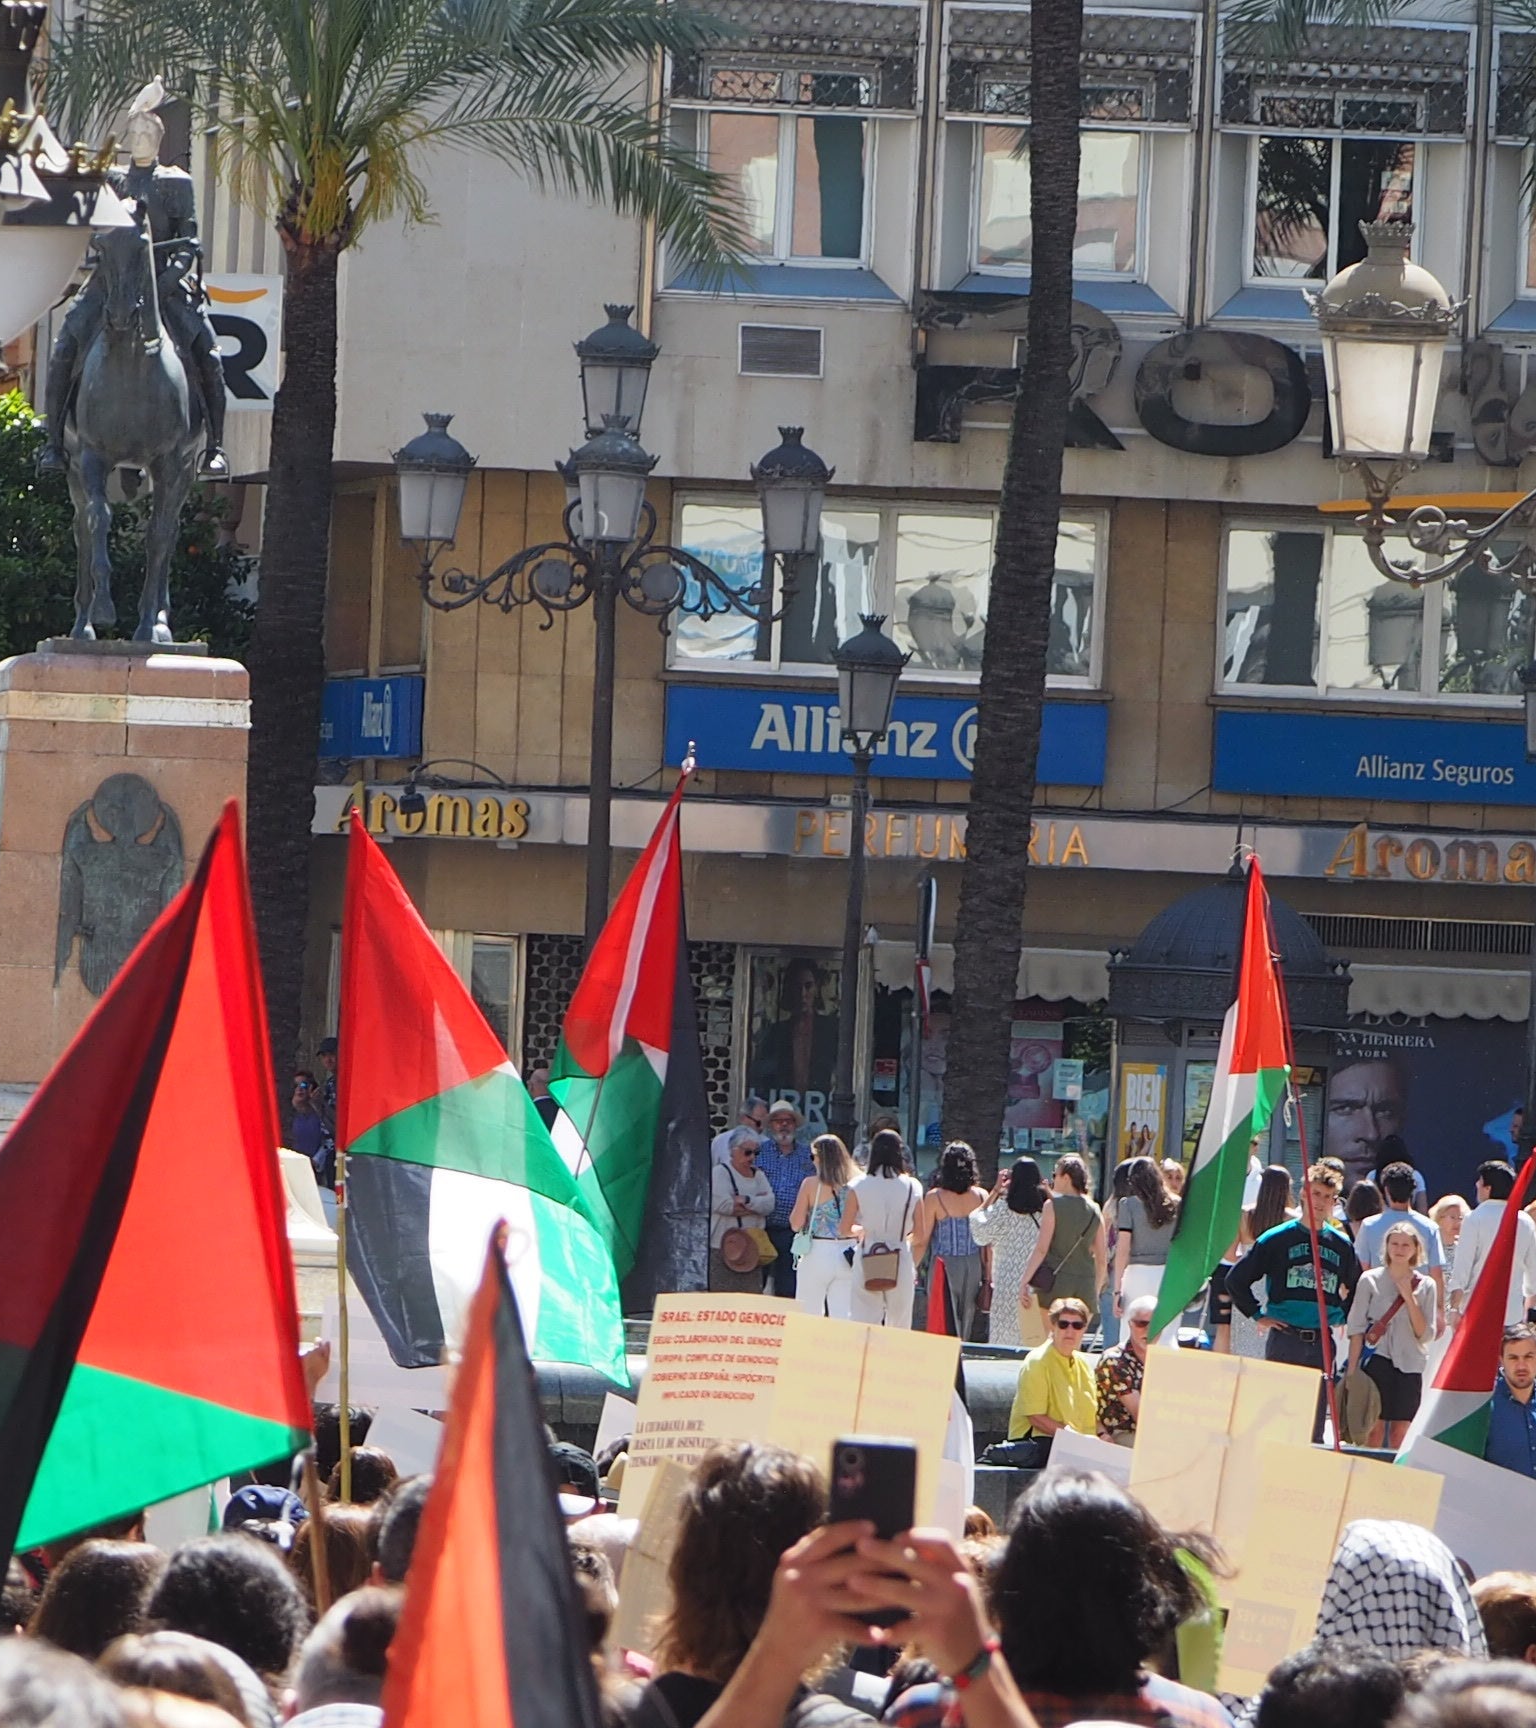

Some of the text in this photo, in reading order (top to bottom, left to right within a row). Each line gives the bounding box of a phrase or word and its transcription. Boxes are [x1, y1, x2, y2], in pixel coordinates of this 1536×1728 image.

[1355, 755, 1515, 786] Allianz Seguros
[793, 809, 1090, 866] PERFUMRIA
[1362, 1033, 1436, 1048] HERRERA
[696, 1311, 736, 1323] ESTADO
[730, 1336, 745, 1345] DEL
[724, 1354, 735, 1363] DE
